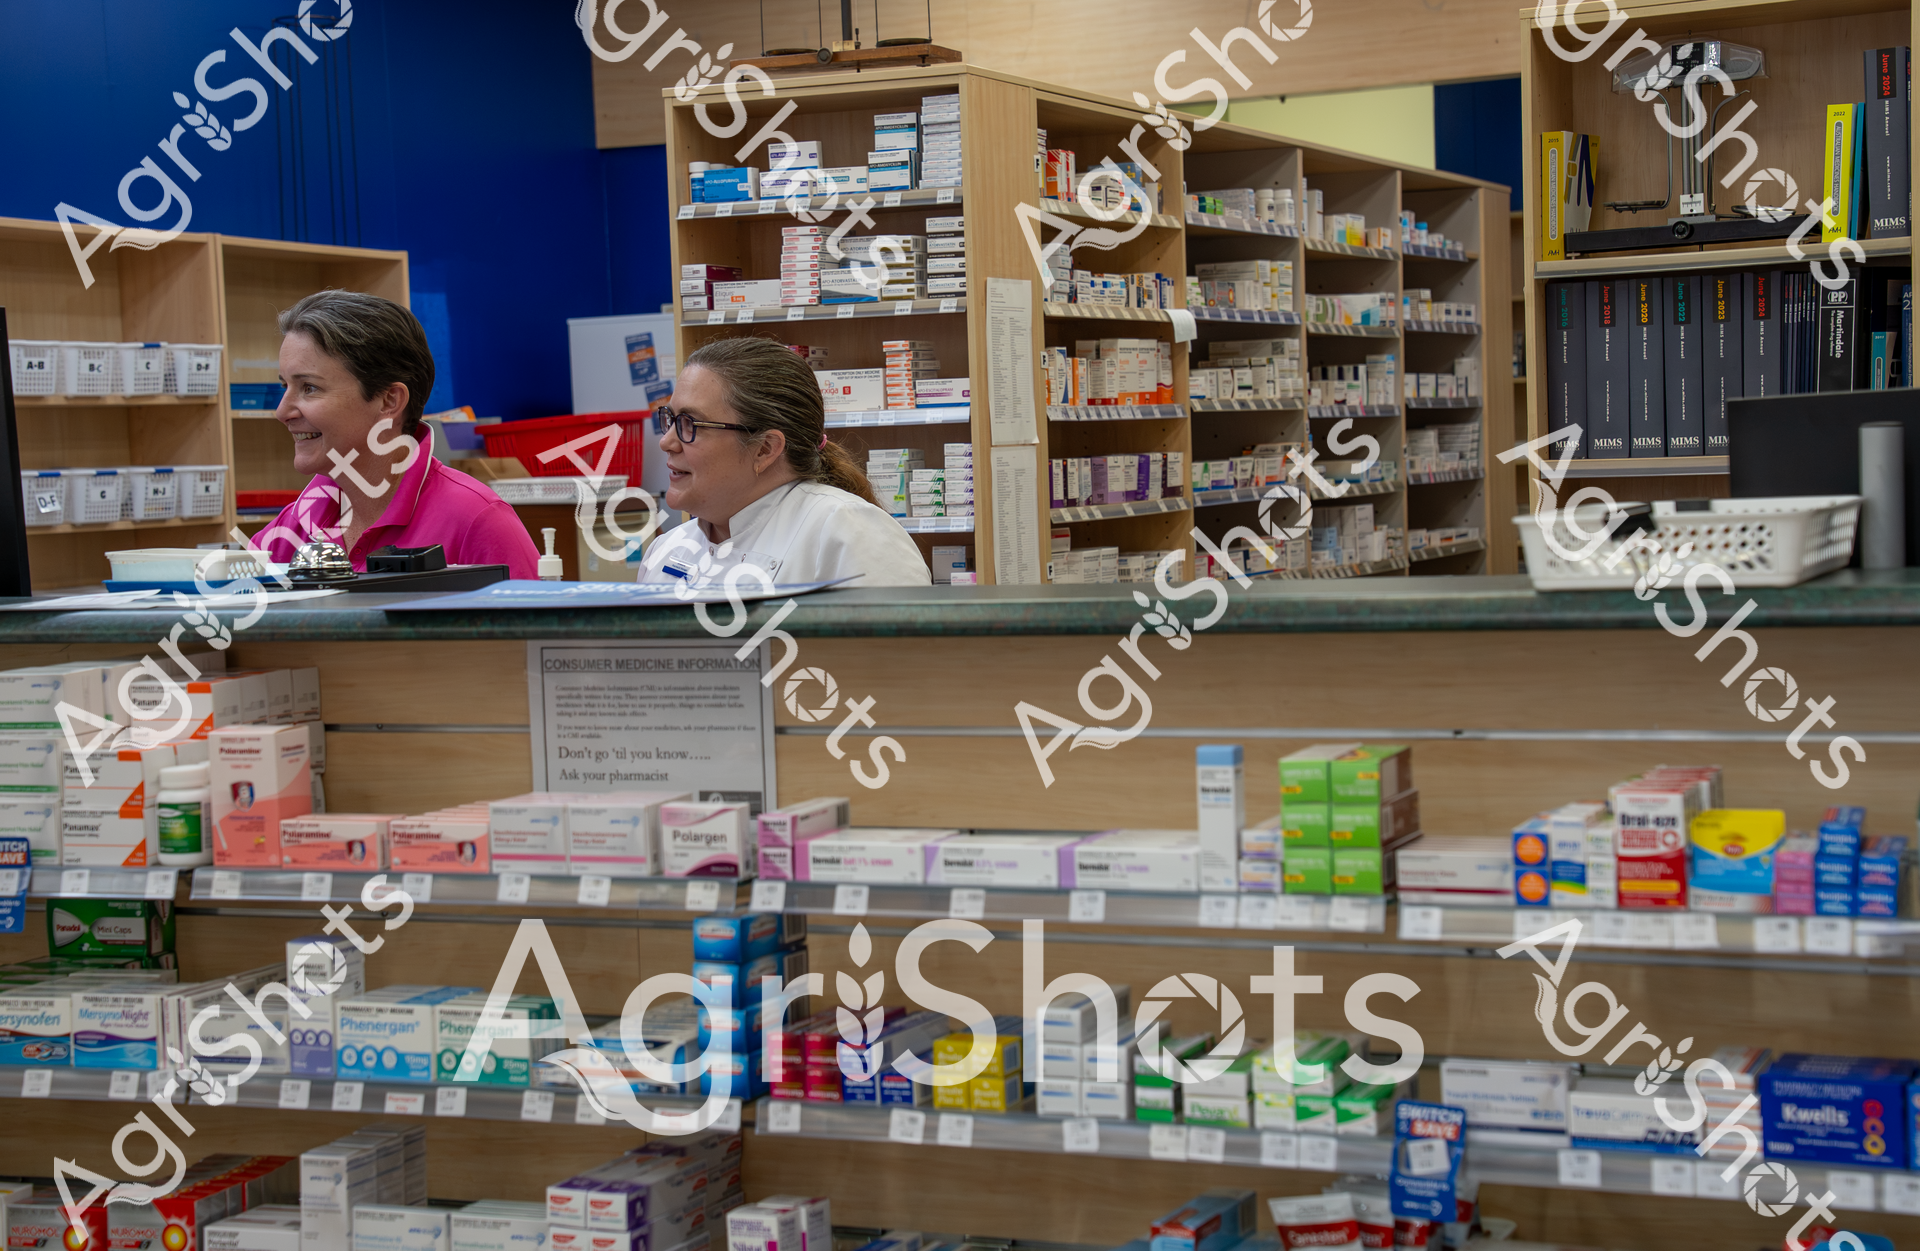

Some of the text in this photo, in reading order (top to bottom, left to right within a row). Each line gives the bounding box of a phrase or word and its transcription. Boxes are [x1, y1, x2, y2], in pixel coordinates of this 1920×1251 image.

[1882, 53, 1890, 96] June 2024
[1874, 216, 1906, 228] MIMS
[1641, 303, 1649, 323] 2020
[1678, 302, 1686, 323] 2022
[1758, 297, 1766, 317] 2024
[1836, 310, 1844, 359] Martindale
[26, 361, 45, 370] A-B
[1556, 440, 1580, 449] MIMS
[1594, 438, 1623, 447] MIMS
[1633, 437, 1662, 446] MIMS
[1671, 436, 1700, 445] MIMS
[152, 487, 166, 497] H-J
[205, 485, 210, 493] K
[544, 658, 760, 670] CONSUMER MEDICINE INFORMATION
[219, 747, 261, 756] Polaramine
[558, 746, 591, 760] Don’t
[595, 750, 609, 763] go
[630, 751, 652, 763] you
[560, 769, 669, 785] Ask your pharmacist
[63, 822, 101, 832] Panamax
[282, 830, 332, 839] Polaramine
[392, 831, 441, 841] Polaramine
[672, 830, 728, 847] Polargen
[56, 923, 81, 933] Panadol
[98, 926, 133, 935] Mini Caps
[340, 1017, 415, 1036] Phenergan
[439, 1020, 513, 1038] Phenergan
[1397, 1104, 1464, 1125] SWITCH
[1781, 1103, 1849, 1127] Kwells
[1413, 1121, 1458, 1140] SAVE
[11, 1226, 60, 1238] NUROMOL
[110, 1226, 159, 1239] NUROMOL
[1289, 1228, 1346, 1246] Canesten
